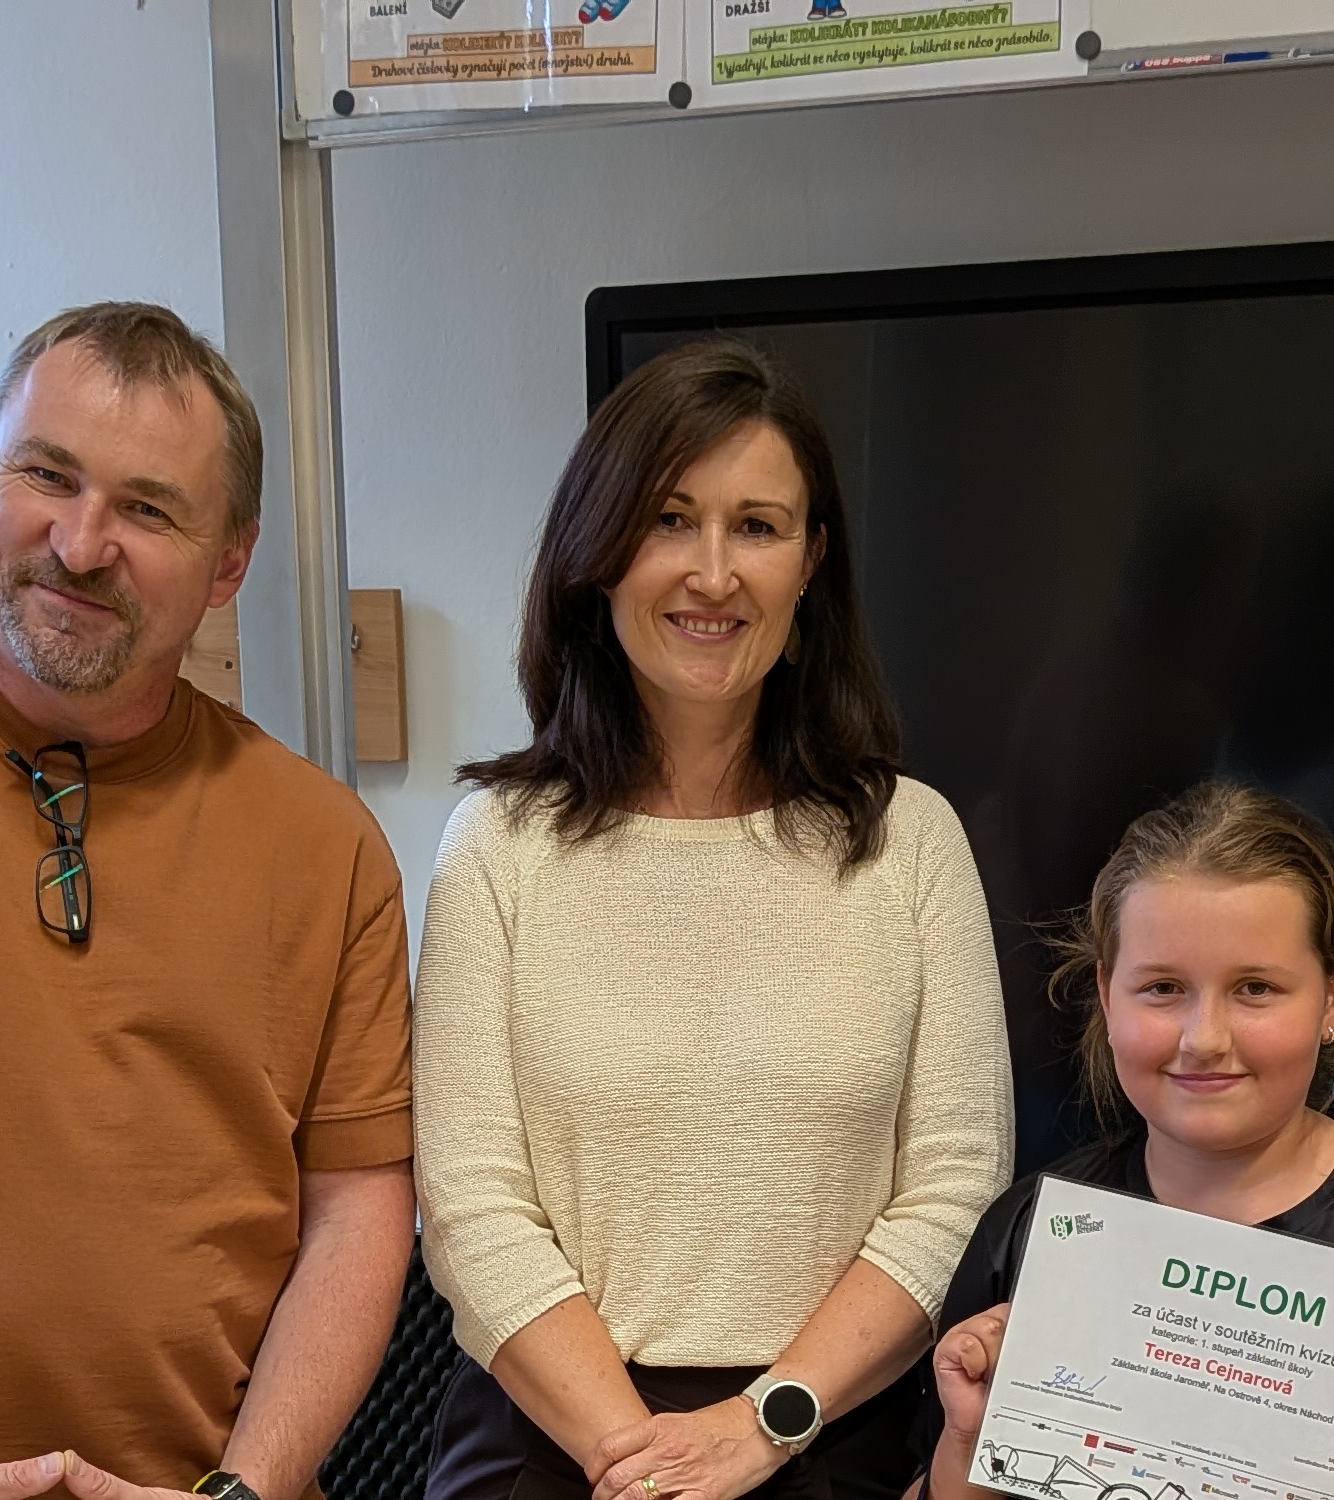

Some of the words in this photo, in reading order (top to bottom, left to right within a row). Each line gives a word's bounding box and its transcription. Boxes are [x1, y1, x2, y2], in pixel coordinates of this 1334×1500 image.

[369, 2, 408, 18] BALENÍ
[751, 29, 788, 52] otázka:
[789, 19, 869, 45] KOLIKRÁT?
[871, 3, 1009, 37] KOLIKANÁSOBNÝ?
[371, 59, 416, 78] Druhové
[416, 60, 459, 79] číslovky
[461, 56, 507, 78] označují
[596, 51, 634, 67] druhů.
[716, 56, 769, 79] Vyjadřují,
[770, 52, 811, 69] kolikrát
[812, 53, 825, 65] se
[825, 48, 851, 64] něco
[910, 38, 952, 56] kolikrát
[953, 40, 966, 51] se
[968, 35, 994, 50] něco
[995, 28, 1054, 52] znásobilo.
[1161, 1257, 1327, 1327] DIPLOM
[1131, 1303, 1151, 1318] za
[1156, 1306, 1199, 1330] účast
[1202, 1320, 1212, 1333] v
[1214, 1325, 1295, 1356] soutěžním
[1151, 1326, 1199, 1346] kategorie:
[1201, 1339, 1209, 1349] 1.
[1211, 1343, 1244, 1360] stupeň
[1245, 1352, 1286, 1370] základní
[1287, 1361, 1314, 1379] školy
[1111, 1357, 1149, 1374] Základní
[1149, 1367, 1173, 1381] škola
[1173, 1374, 1212, 1392] Jaroměř,
[1213, 1384, 1226, 1395] Na
[1227, 1387, 1262, 1405] Ostrově
[1273, 1401, 1298, 1415] okres
[1299, 1407, 1334, 1424] Náchod
[1145, 1342, 1201, 1370] Tereza
[1205, 1359, 1294, 1395] Cejnarová
[1211, 1486, 1240, 1500] Microsoft
